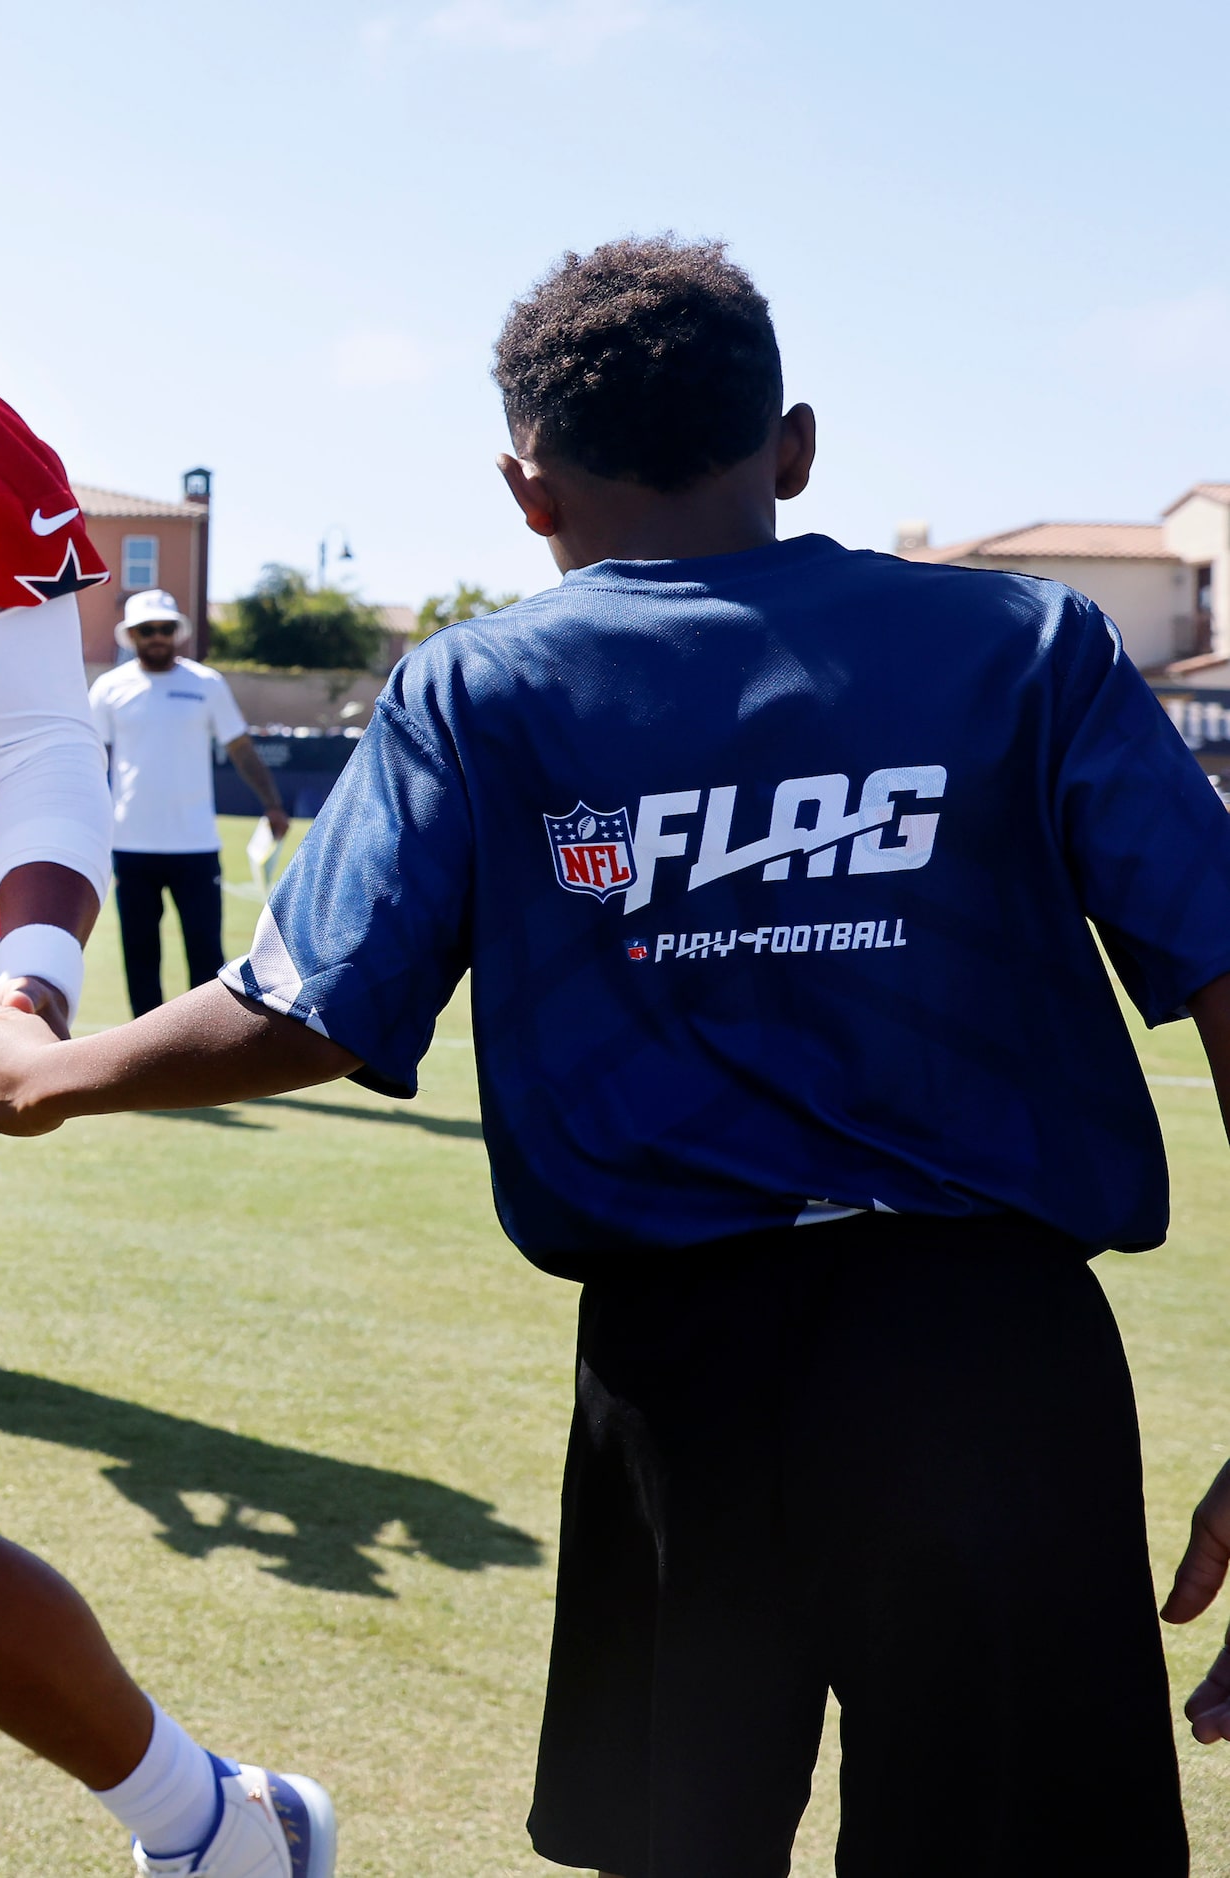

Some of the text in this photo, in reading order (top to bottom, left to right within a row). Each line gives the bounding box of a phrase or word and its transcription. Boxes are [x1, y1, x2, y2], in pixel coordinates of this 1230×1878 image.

[560, 764, 948, 916] NFL FLAG
[654, 929, 737, 963] PLAY
[754, 918, 908, 954] FOOTBALL
